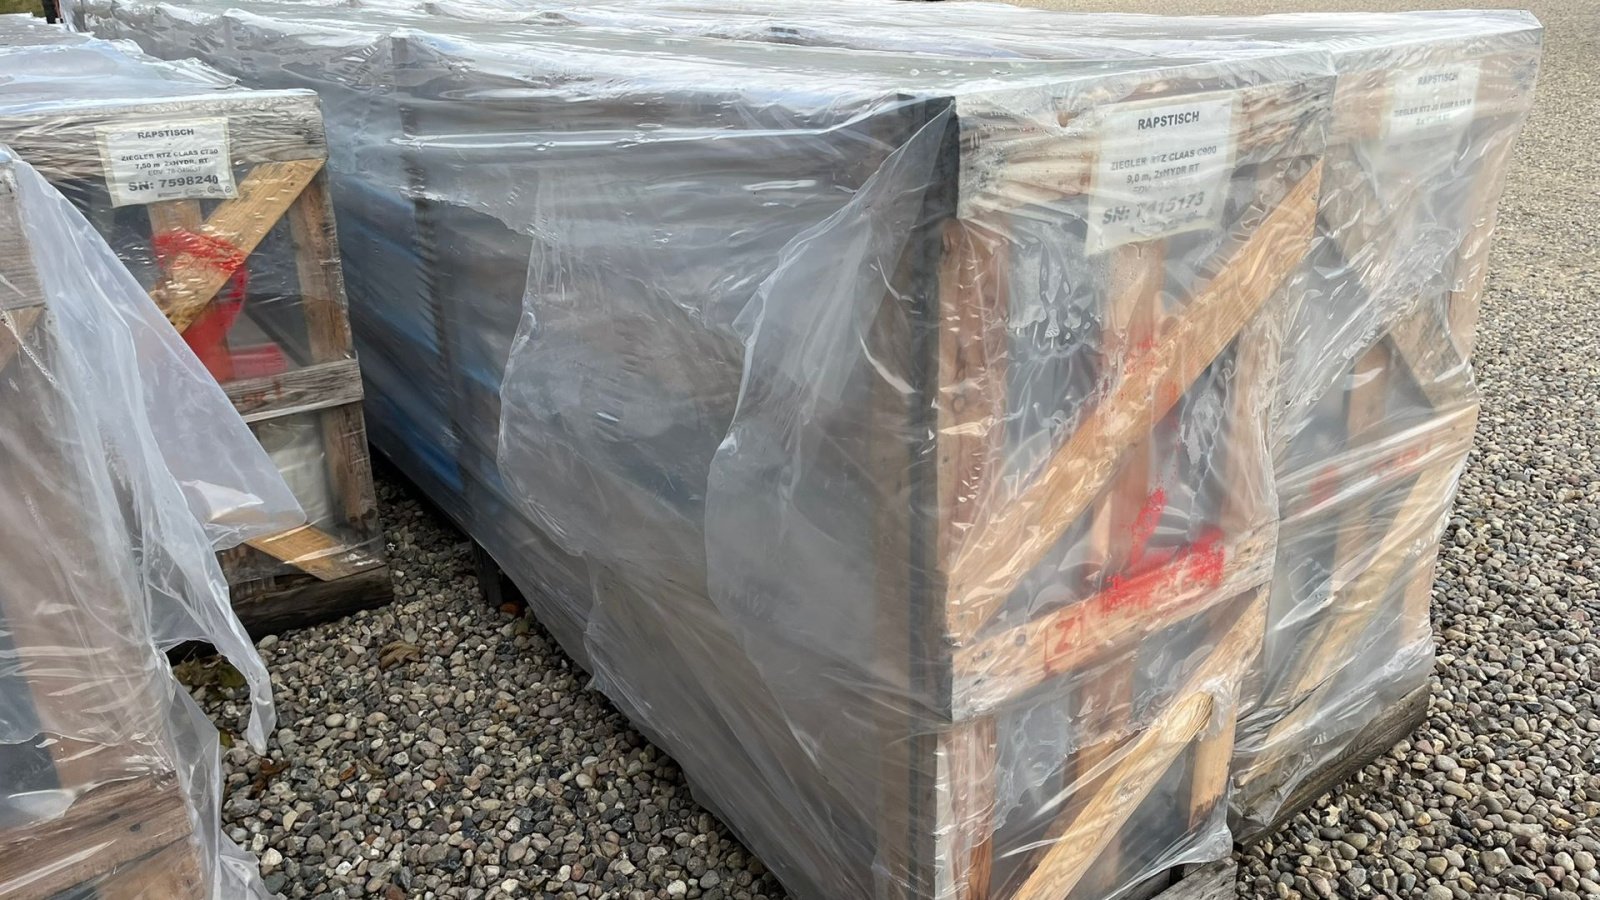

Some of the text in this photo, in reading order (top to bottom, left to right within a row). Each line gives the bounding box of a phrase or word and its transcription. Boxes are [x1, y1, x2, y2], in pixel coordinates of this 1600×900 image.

[1418, 72, 1458, 85] RAPSTISCH
[1138, 111, 1199, 130] RAPSTISCH
[137, 129, 194, 139] RAPSTISCH
[121, 153, 154, 161] ZIEGLER
[156, 151, 172, 159] RTZ
[173, 149, 199, 158] CLAAS
[1111, 157, 1147, 171] ZIEGLER
[1168, 149, 1195, 162] CLAAS
[128, 174, 218, 192] SN: 7598240
[1102, 204, 1131, 225] SN:
